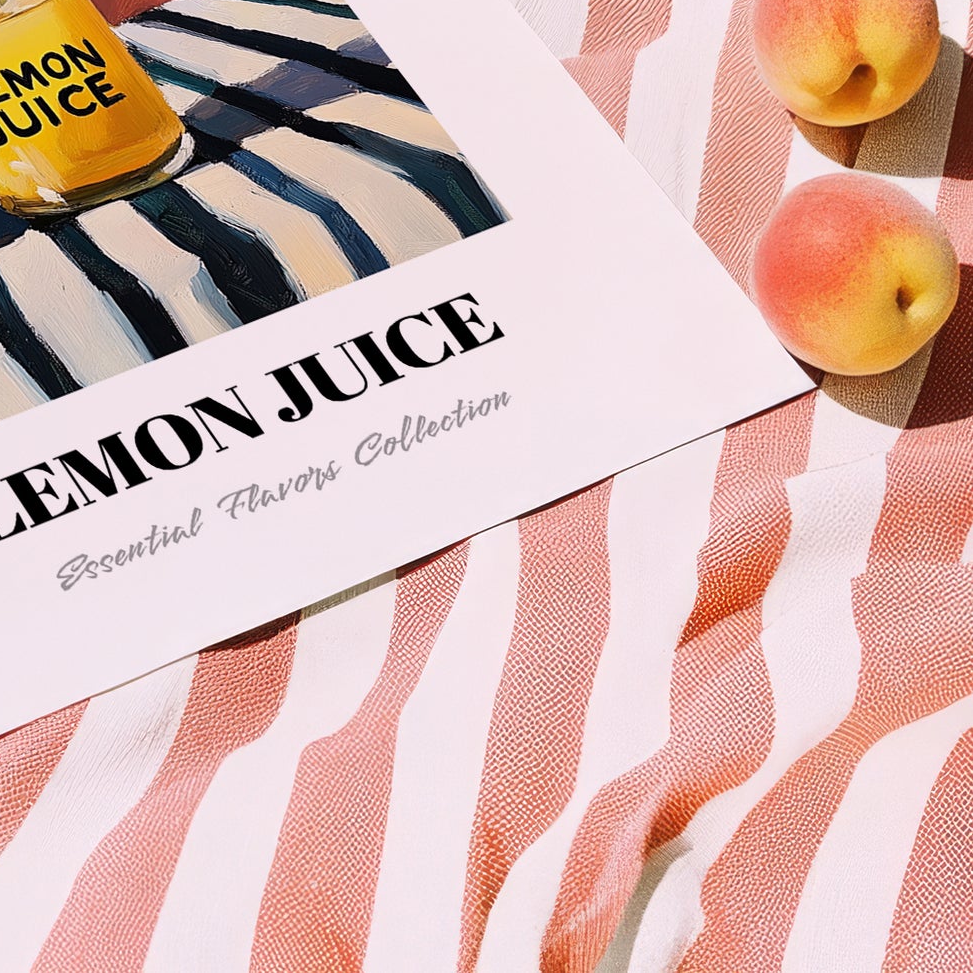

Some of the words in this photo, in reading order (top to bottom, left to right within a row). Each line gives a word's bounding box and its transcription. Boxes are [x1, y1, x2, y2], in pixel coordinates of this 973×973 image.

[264, 292, 505, 423] JUICE
[56, 508, 203, 591] Essential
[216, 461, 341, 519] Flavors
[354, 389, 512, 467] Collection
